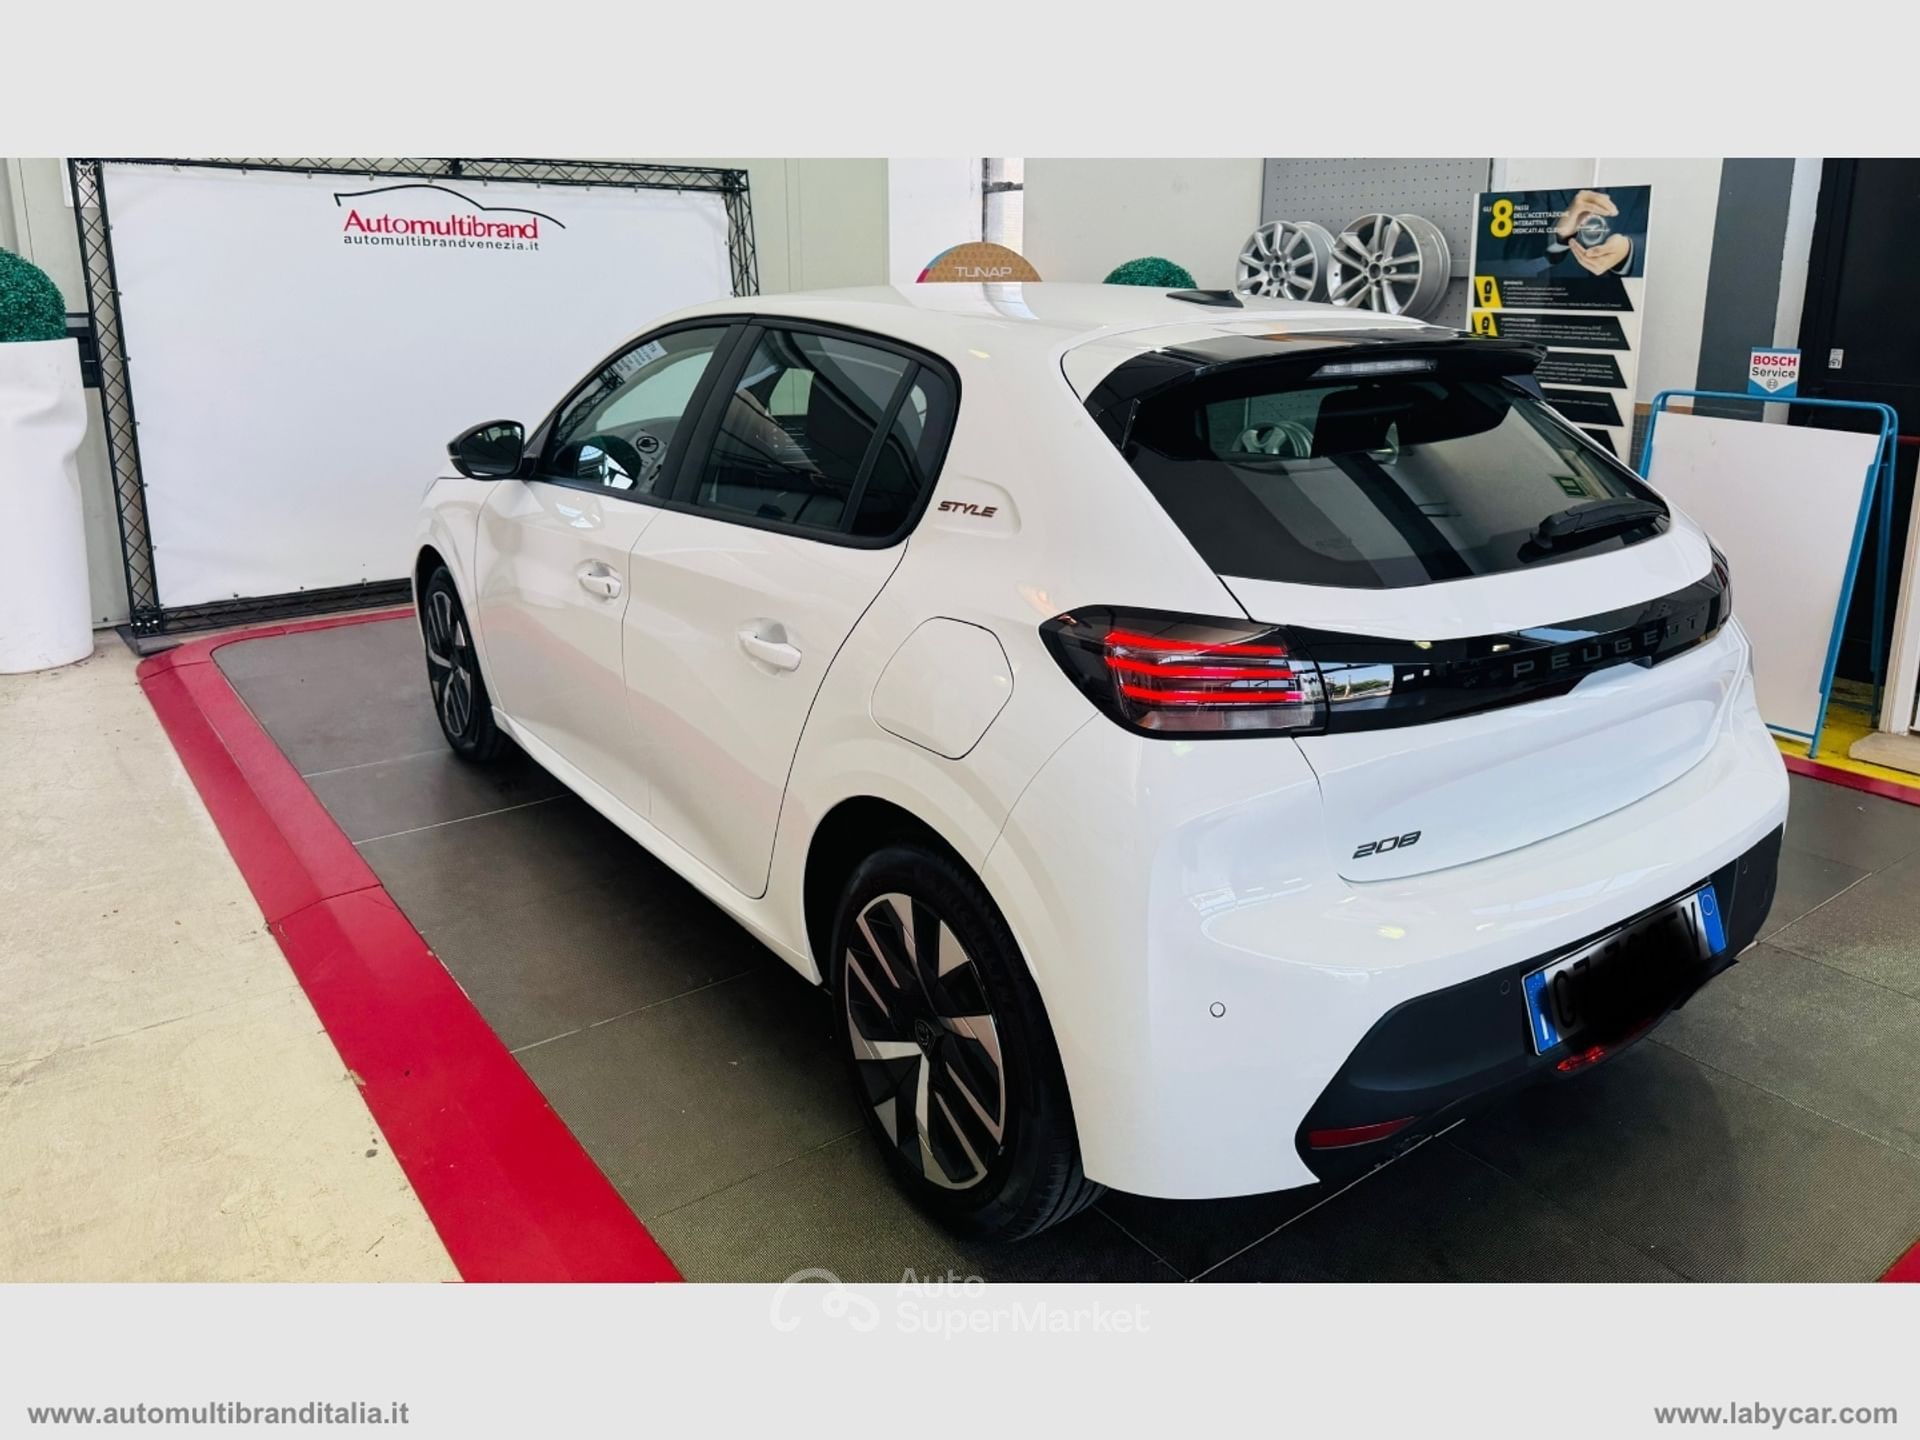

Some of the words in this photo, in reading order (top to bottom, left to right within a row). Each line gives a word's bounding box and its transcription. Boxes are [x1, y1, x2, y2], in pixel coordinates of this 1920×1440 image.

[343, 209, 539, 240] Automultibrand
[1490, 199, 1513, 238] 8
[343, 233, 540, 251] automultibrandvenezia.it
[954, 266, 1012, 278] TUNAP
[1753, 355, 1797, 367] BOSCH
[1752, 366, 1796, 379] Service
[937, 500, 998, 518] STYLE
[1352, 830, 1422, 860] 208
